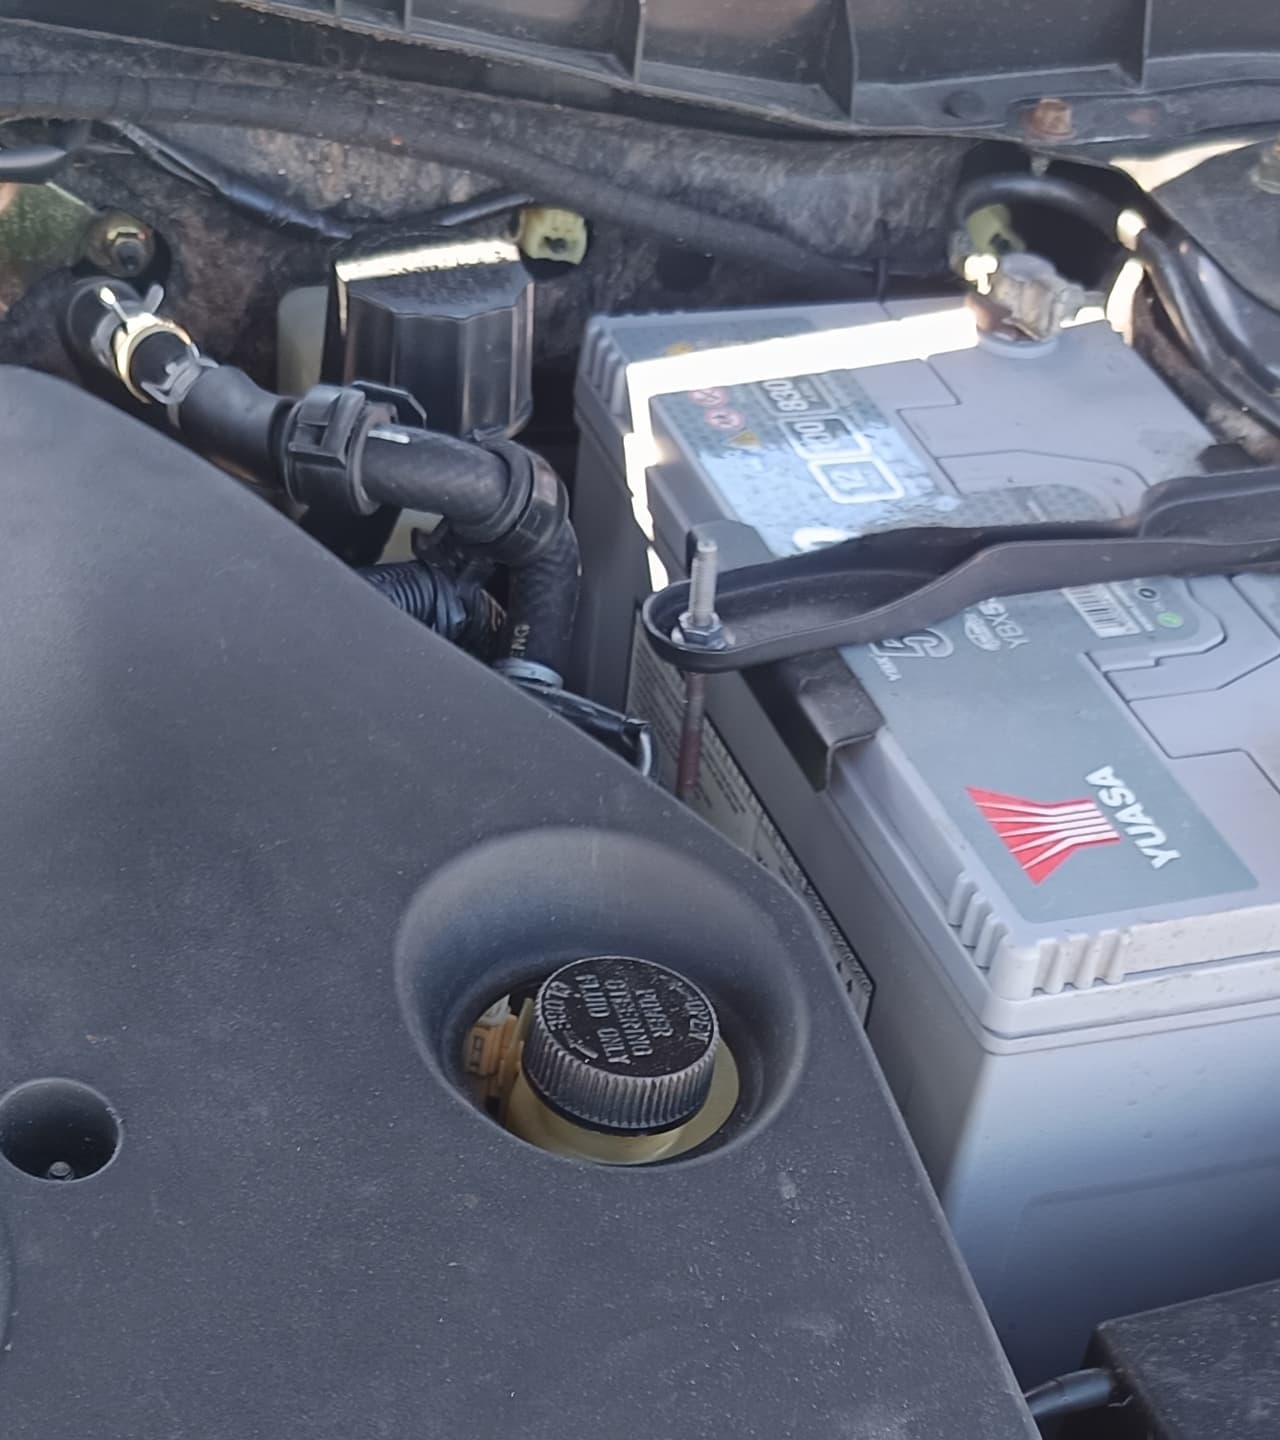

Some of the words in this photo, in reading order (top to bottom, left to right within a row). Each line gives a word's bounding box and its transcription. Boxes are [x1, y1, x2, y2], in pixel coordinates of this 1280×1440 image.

[762, 380, 810, 412] 830
[1085, 765, 1182, 869] YUASA
[574, 973, 611, 1018] FLUID
[596, 1027, 632, 1064] ONLY
[635, 988, 675, 1038] POWER
